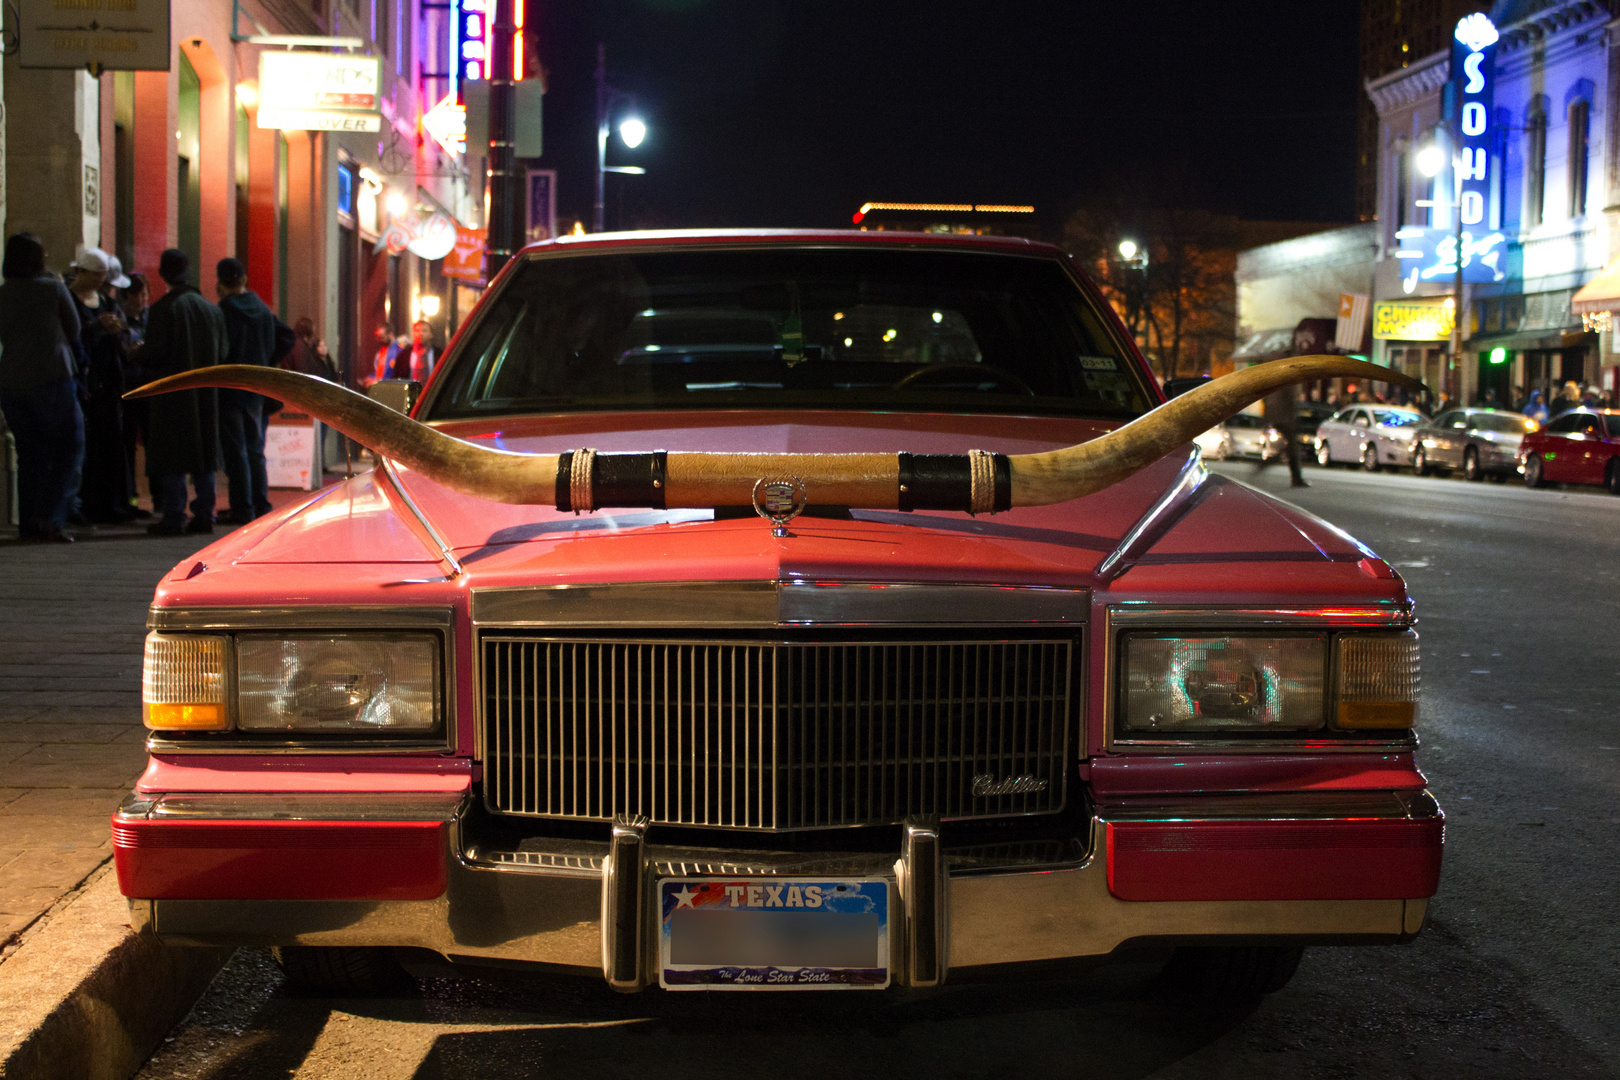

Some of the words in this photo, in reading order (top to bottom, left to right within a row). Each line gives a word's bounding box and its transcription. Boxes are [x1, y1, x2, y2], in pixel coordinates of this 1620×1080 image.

[1461, 52, 1486, 224] SOHO
[972, 773, 1048, 797] Cadillac
[725, 886, 822, 908] TEXAS
[719, 970, 732, 979] The
[734, 968, 763, 983] Lone
[767, 970, 795, 983] Star
[798, 970, 830, 983] State
